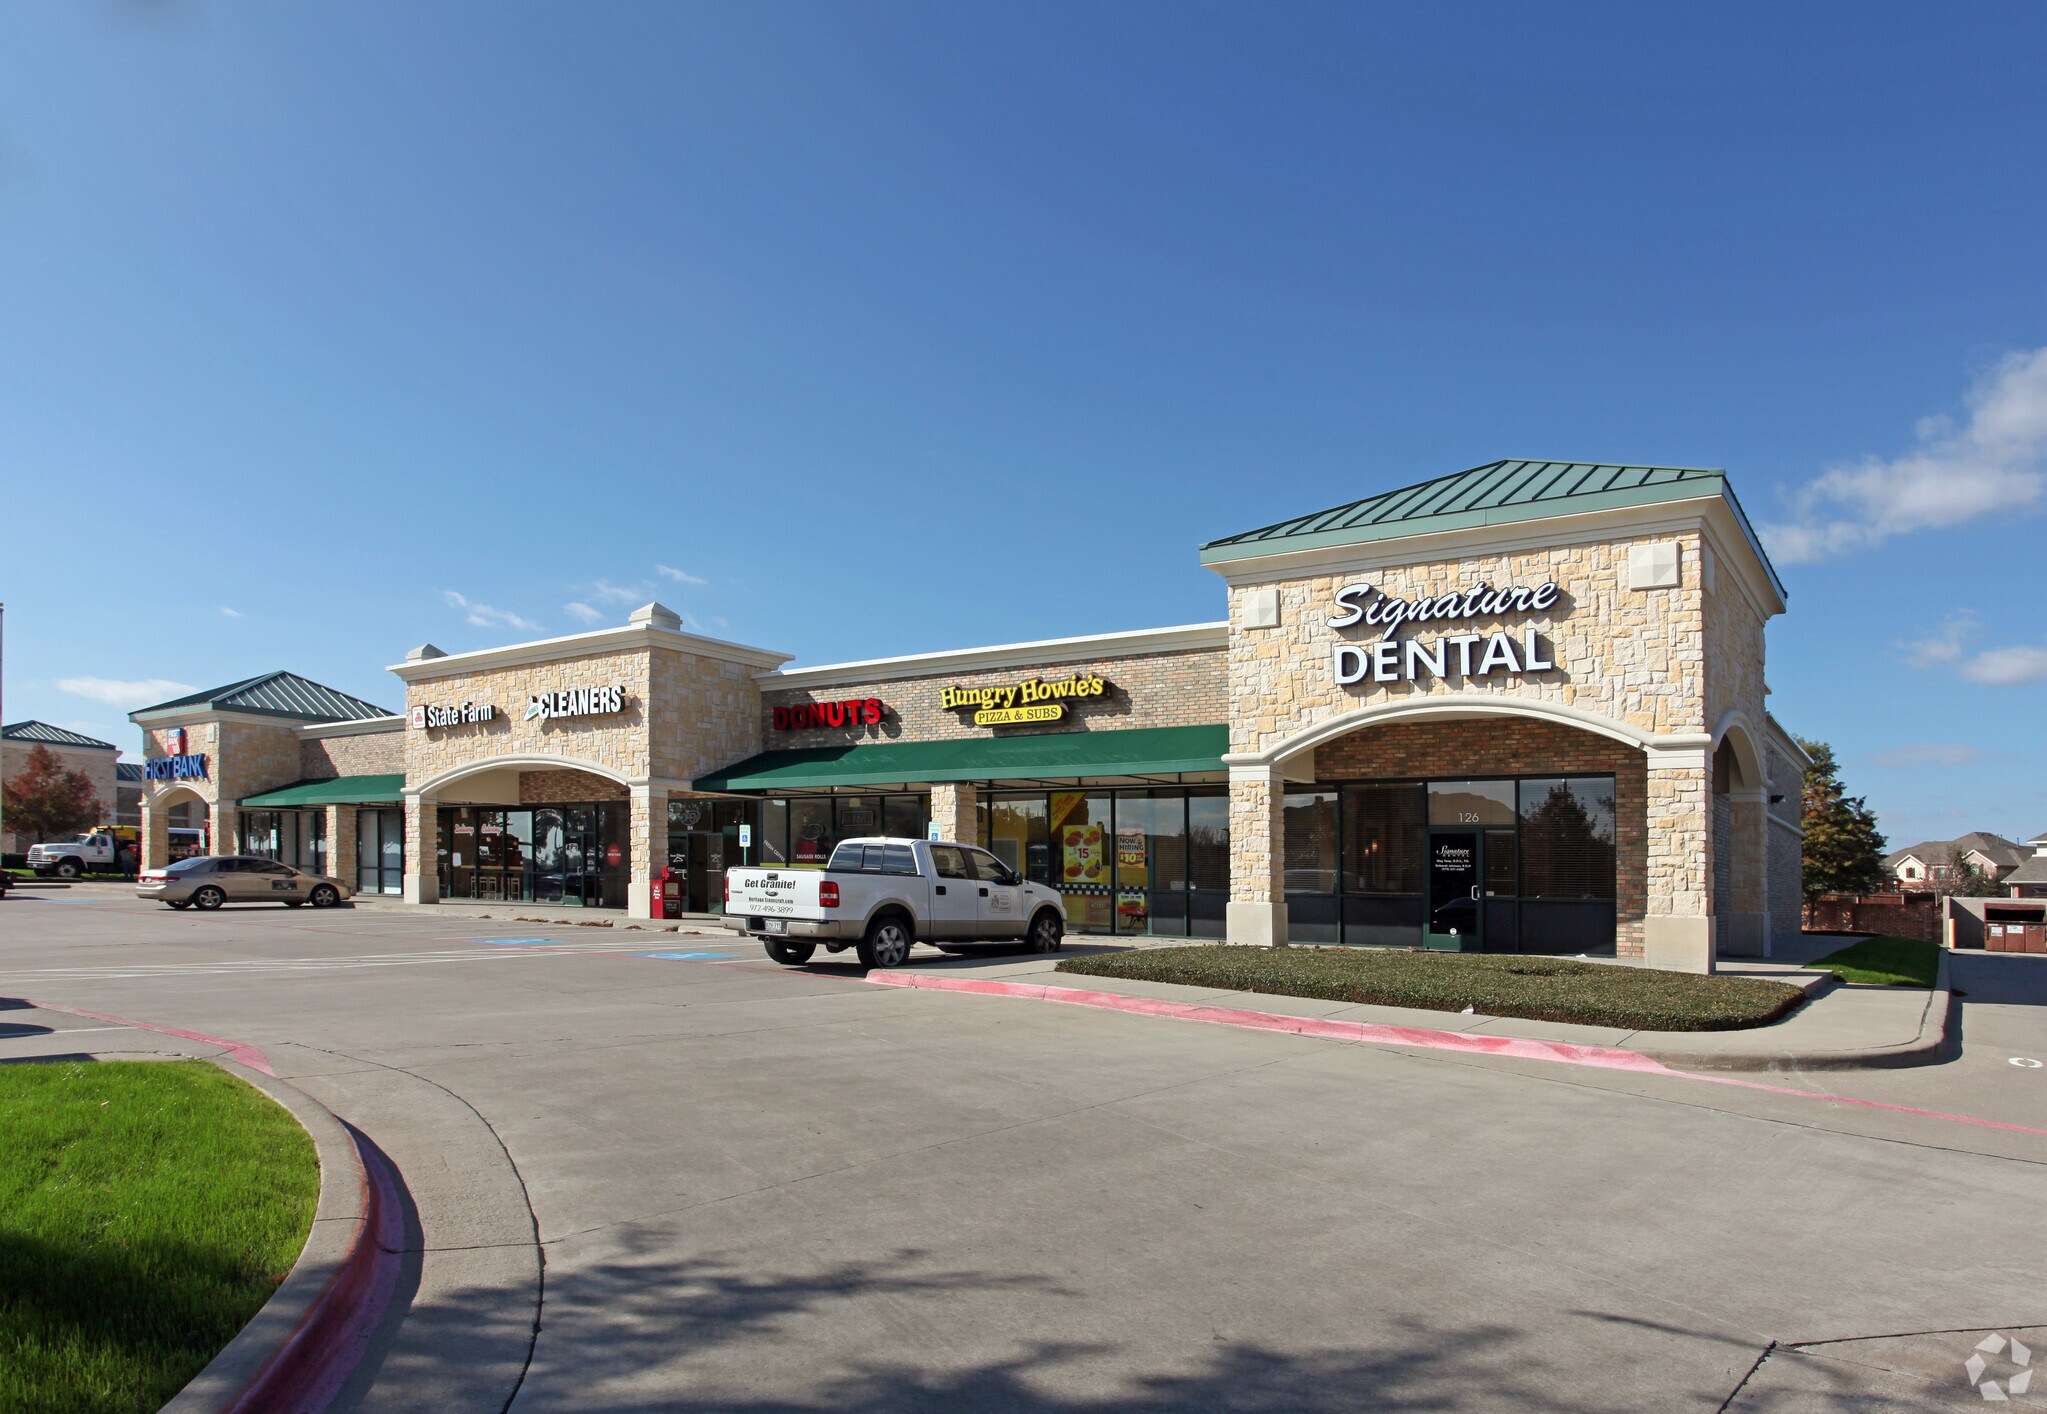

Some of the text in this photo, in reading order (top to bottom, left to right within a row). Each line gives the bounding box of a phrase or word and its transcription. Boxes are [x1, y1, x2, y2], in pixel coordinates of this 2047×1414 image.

[1326, 581, 1558, 640] Signature
[1333, 628, 1552, 685] DENTAL
[538, 684, 622, 720] CLEANERS
[939, 674, 1104, 710] Hungry Howie's
[427, 702, 492, 728] State Farm
[773, 698, 881, 731] DONUTS
[978, 707, 1058, 723] PIZZA & SUBS
[145, 754, 206, 780] FIRST BANK
[1458, 812, 1480, 823] 126
[744, 879, 796, 890] Get Granite!
[749, 904, 794, 914] 972-496-3899
